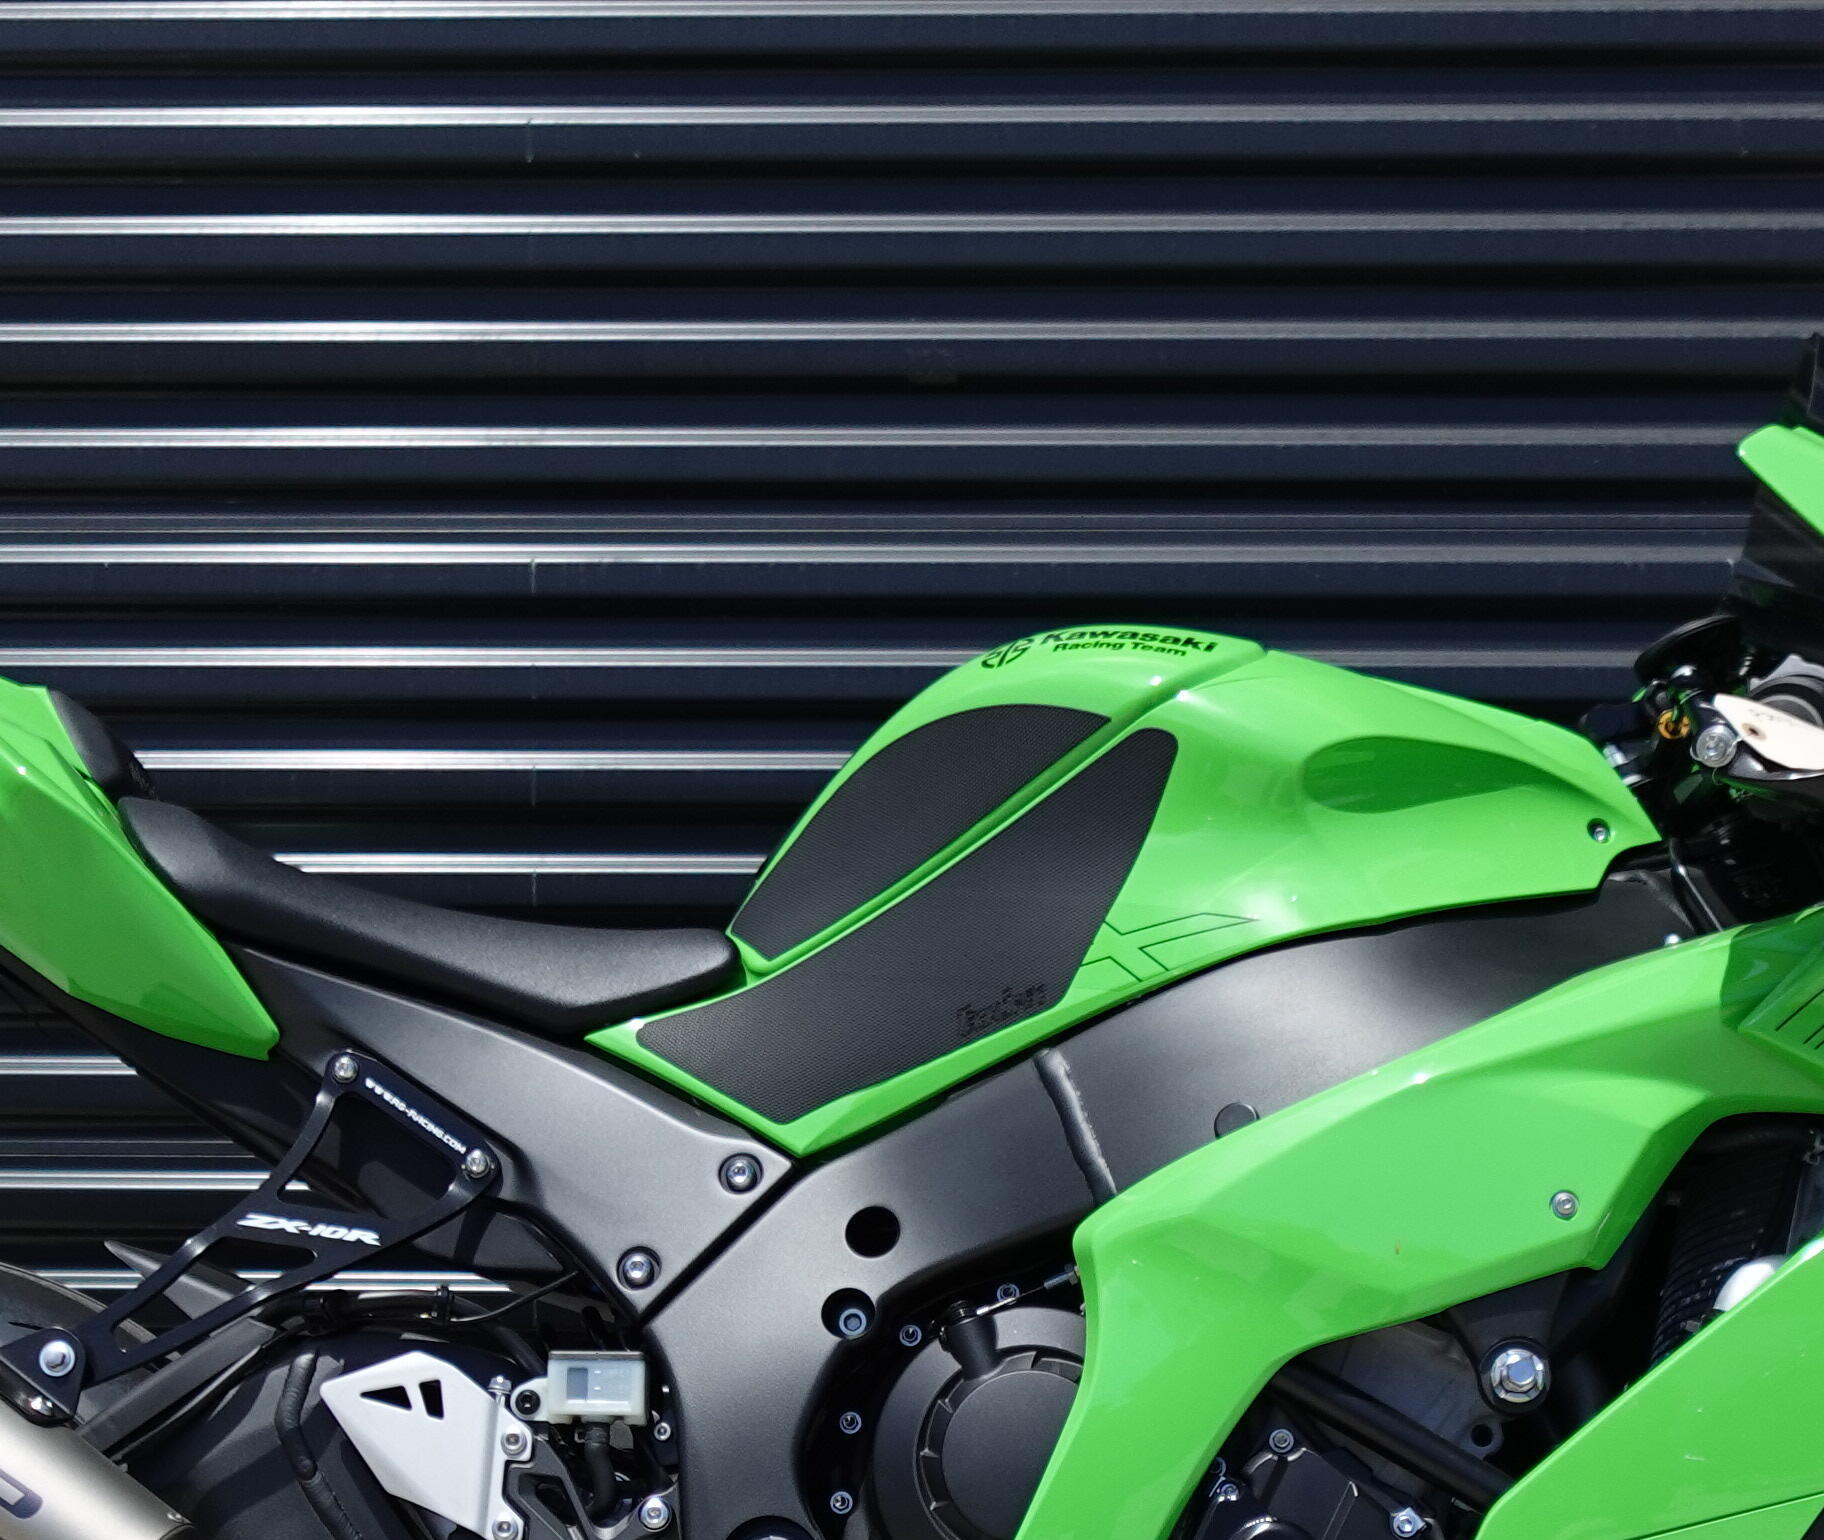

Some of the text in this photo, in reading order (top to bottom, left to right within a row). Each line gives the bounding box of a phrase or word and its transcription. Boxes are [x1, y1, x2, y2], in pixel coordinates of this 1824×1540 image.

[1040, 629, 1220, 653] Kawasaki
[1052, 640, 1188, 657] Racing Team
[236, 1212, 382, 1247] ZX-10R
